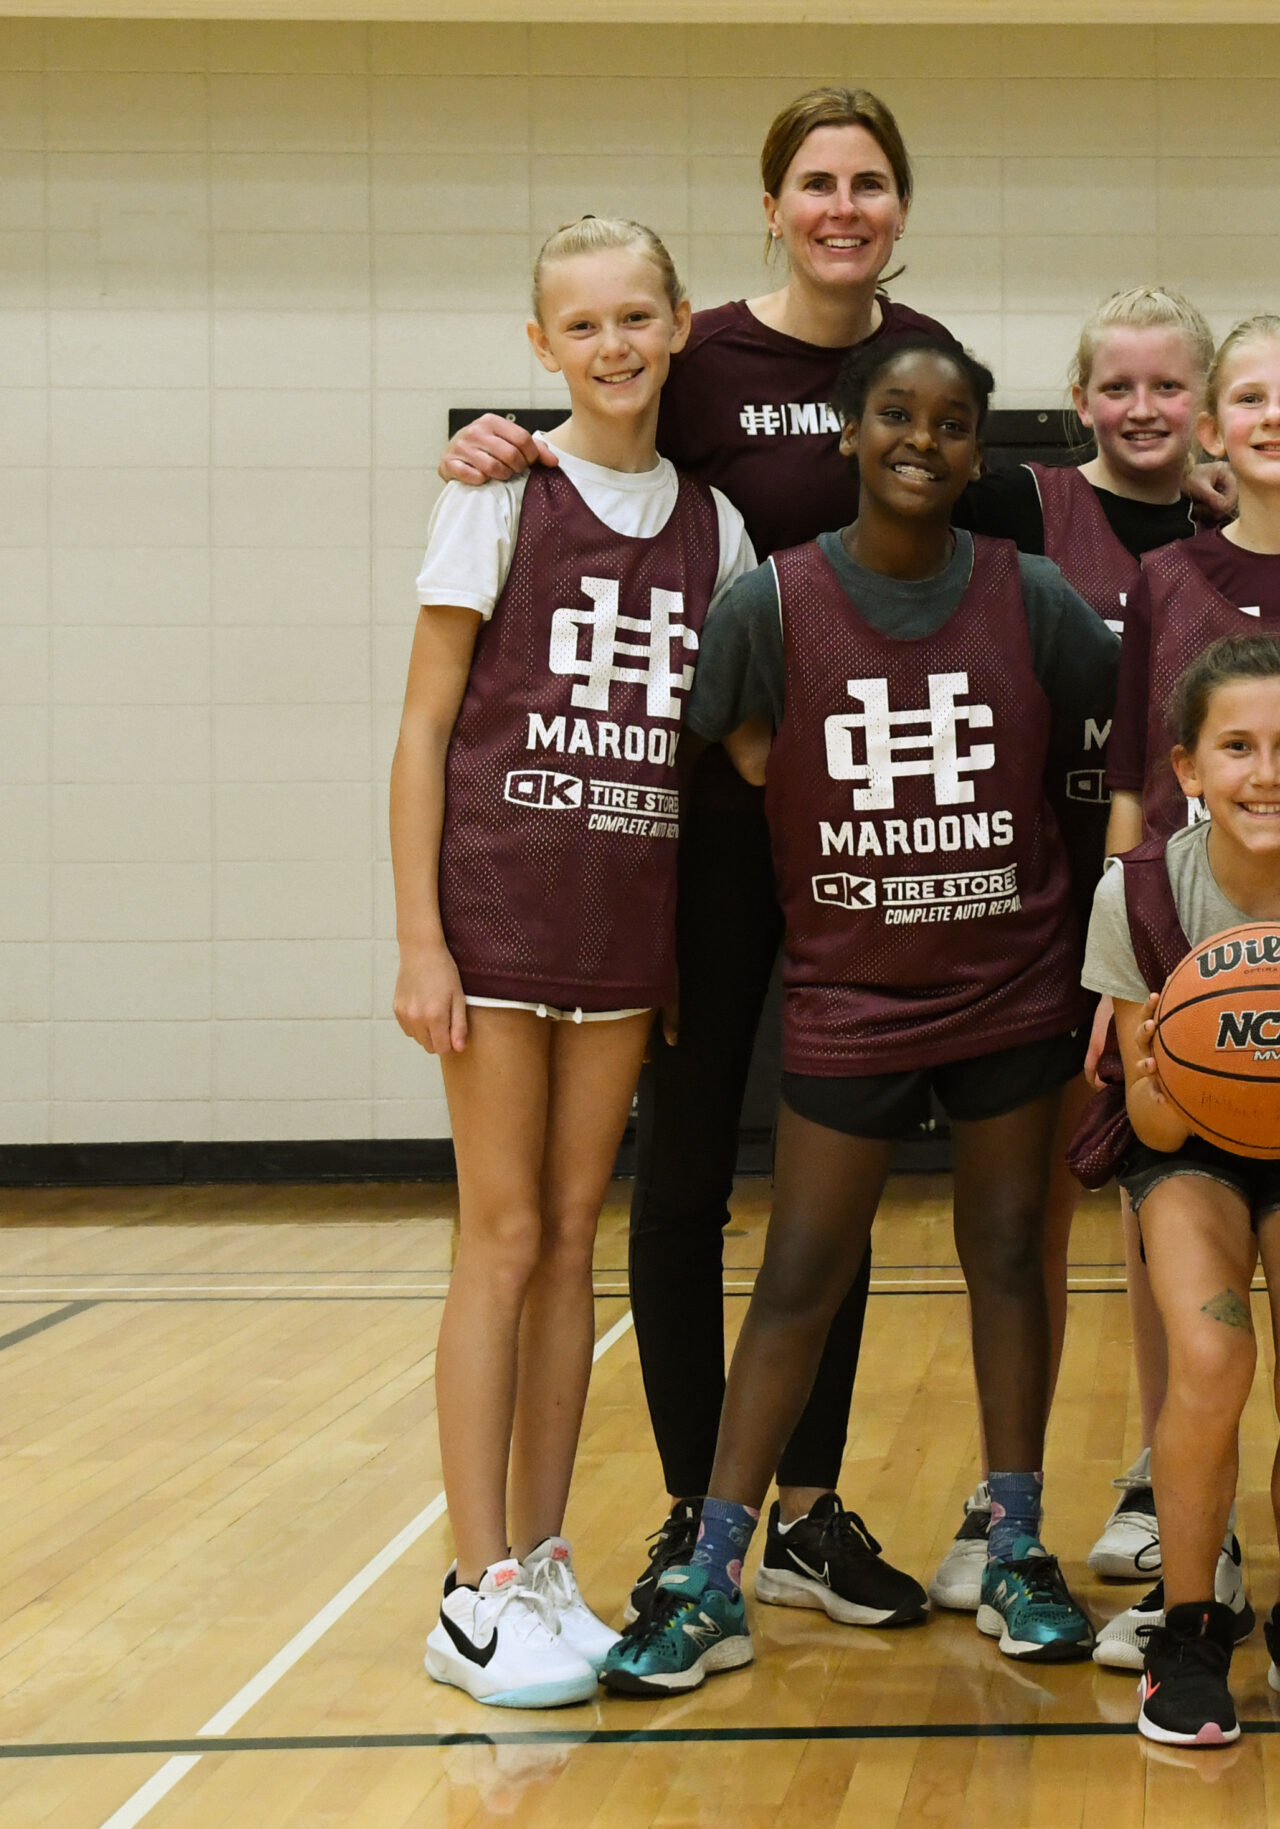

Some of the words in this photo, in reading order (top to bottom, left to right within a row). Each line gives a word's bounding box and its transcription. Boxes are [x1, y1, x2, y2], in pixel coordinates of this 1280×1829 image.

[526, 713, 680, 767] MAROON
[589, 786, 639, 809] TIRE
[588, 813, 650, 836] COMPLETE
[818, 810, 1014, 856] MAROONS
[882, 881, 936, 901] TIRE
[885, 905, 951, 925] COMPLETE
[953, 902, 986, 920] AUTO
